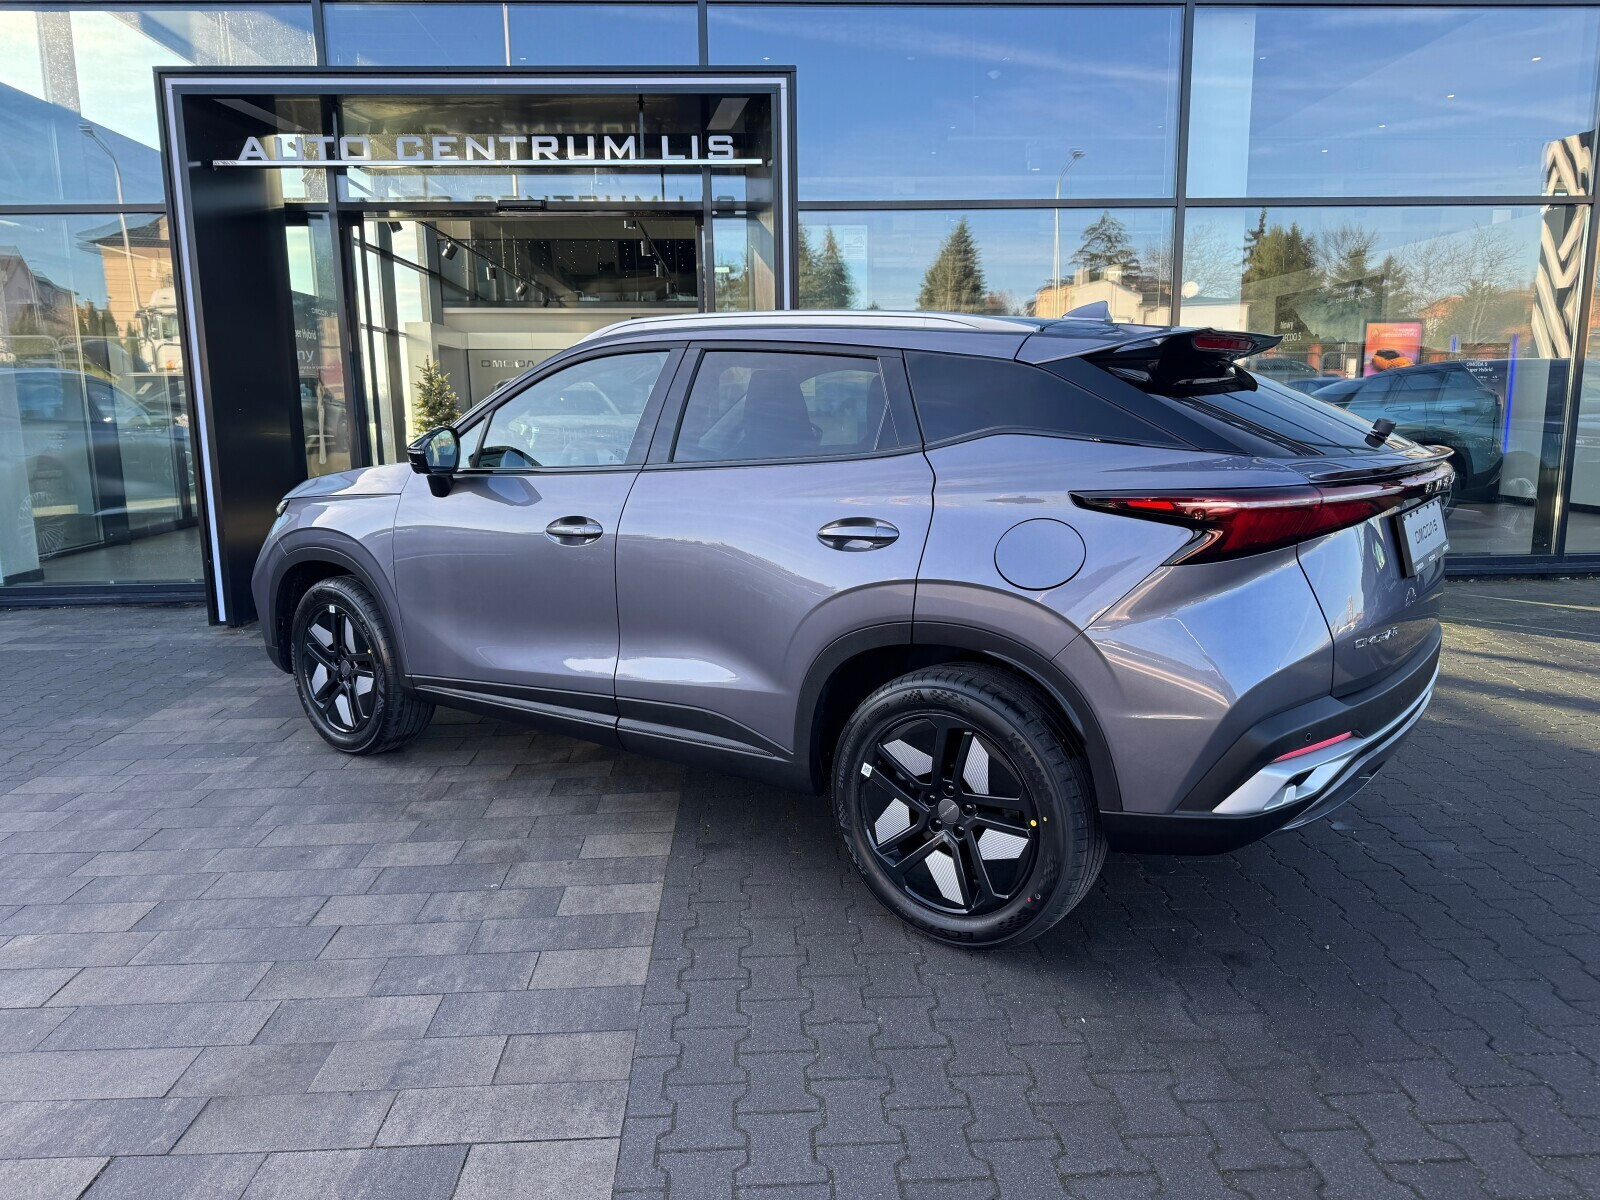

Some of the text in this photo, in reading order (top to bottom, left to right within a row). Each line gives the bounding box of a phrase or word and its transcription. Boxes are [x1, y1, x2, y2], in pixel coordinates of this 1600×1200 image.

[237, 135, 734, 161] AUTO CENTRUM LIS
[481, 359, 535, 368] OMODA
